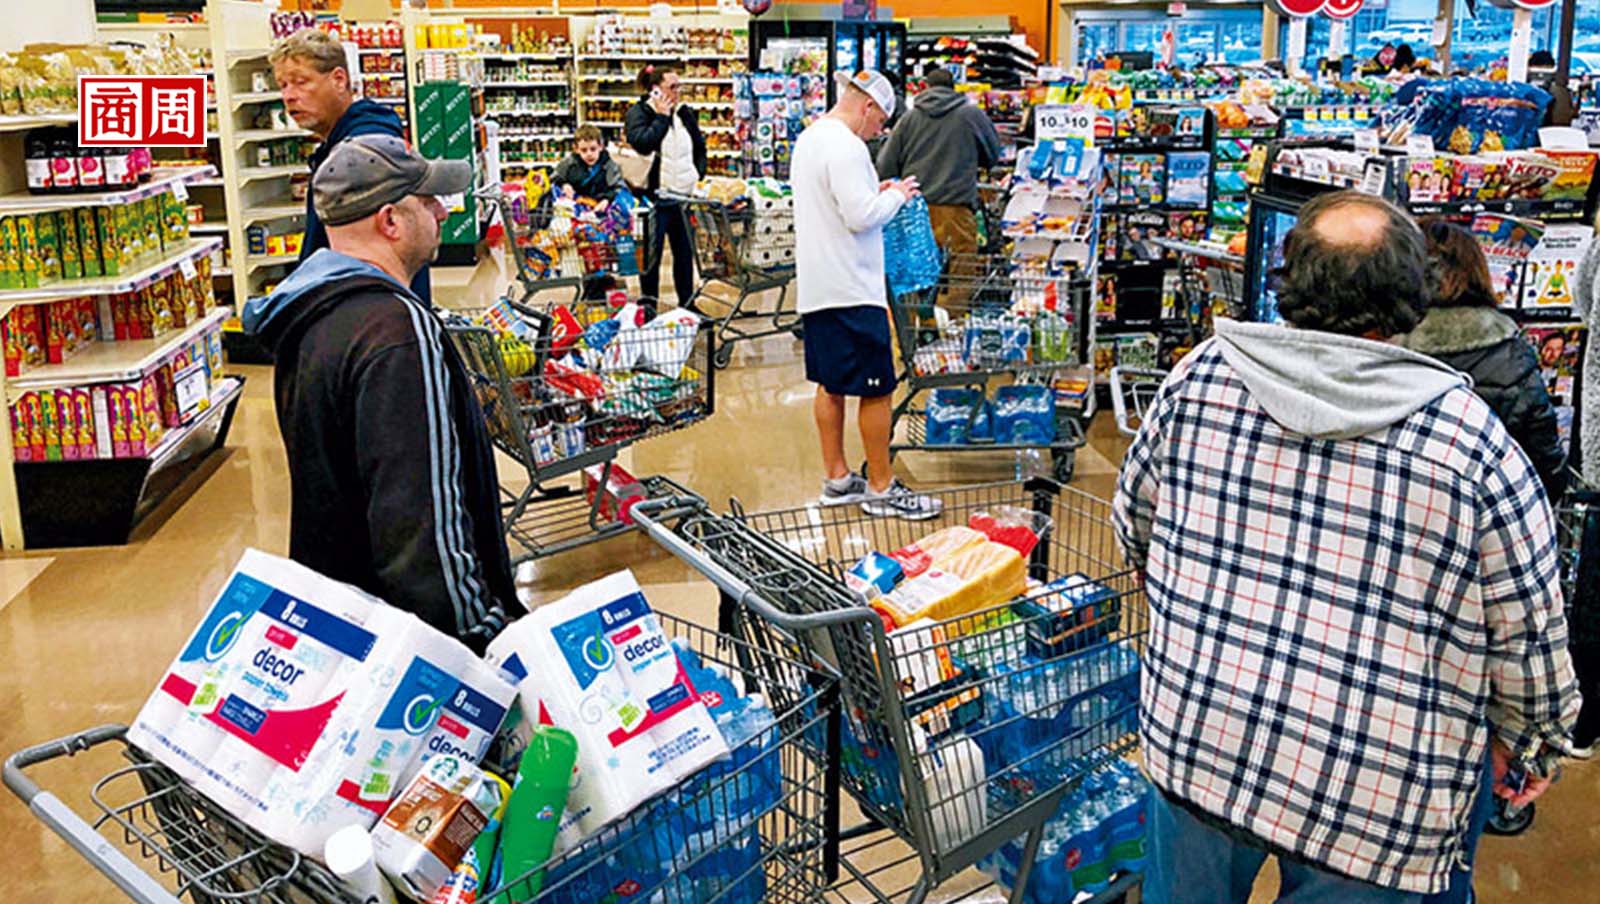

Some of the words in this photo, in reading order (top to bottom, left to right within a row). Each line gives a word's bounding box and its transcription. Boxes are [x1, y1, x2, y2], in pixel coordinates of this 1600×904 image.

[1040, 116, 1057, 128] 10
[1515, 163, 1558, 178] KETO
[281, 601, 296, 621] 8
[603, 608, 614, 625] 8
[624, 634, 665, 662] decor
[254, 647, 304, 684] decor
[454, 690, 466, 707] 8
